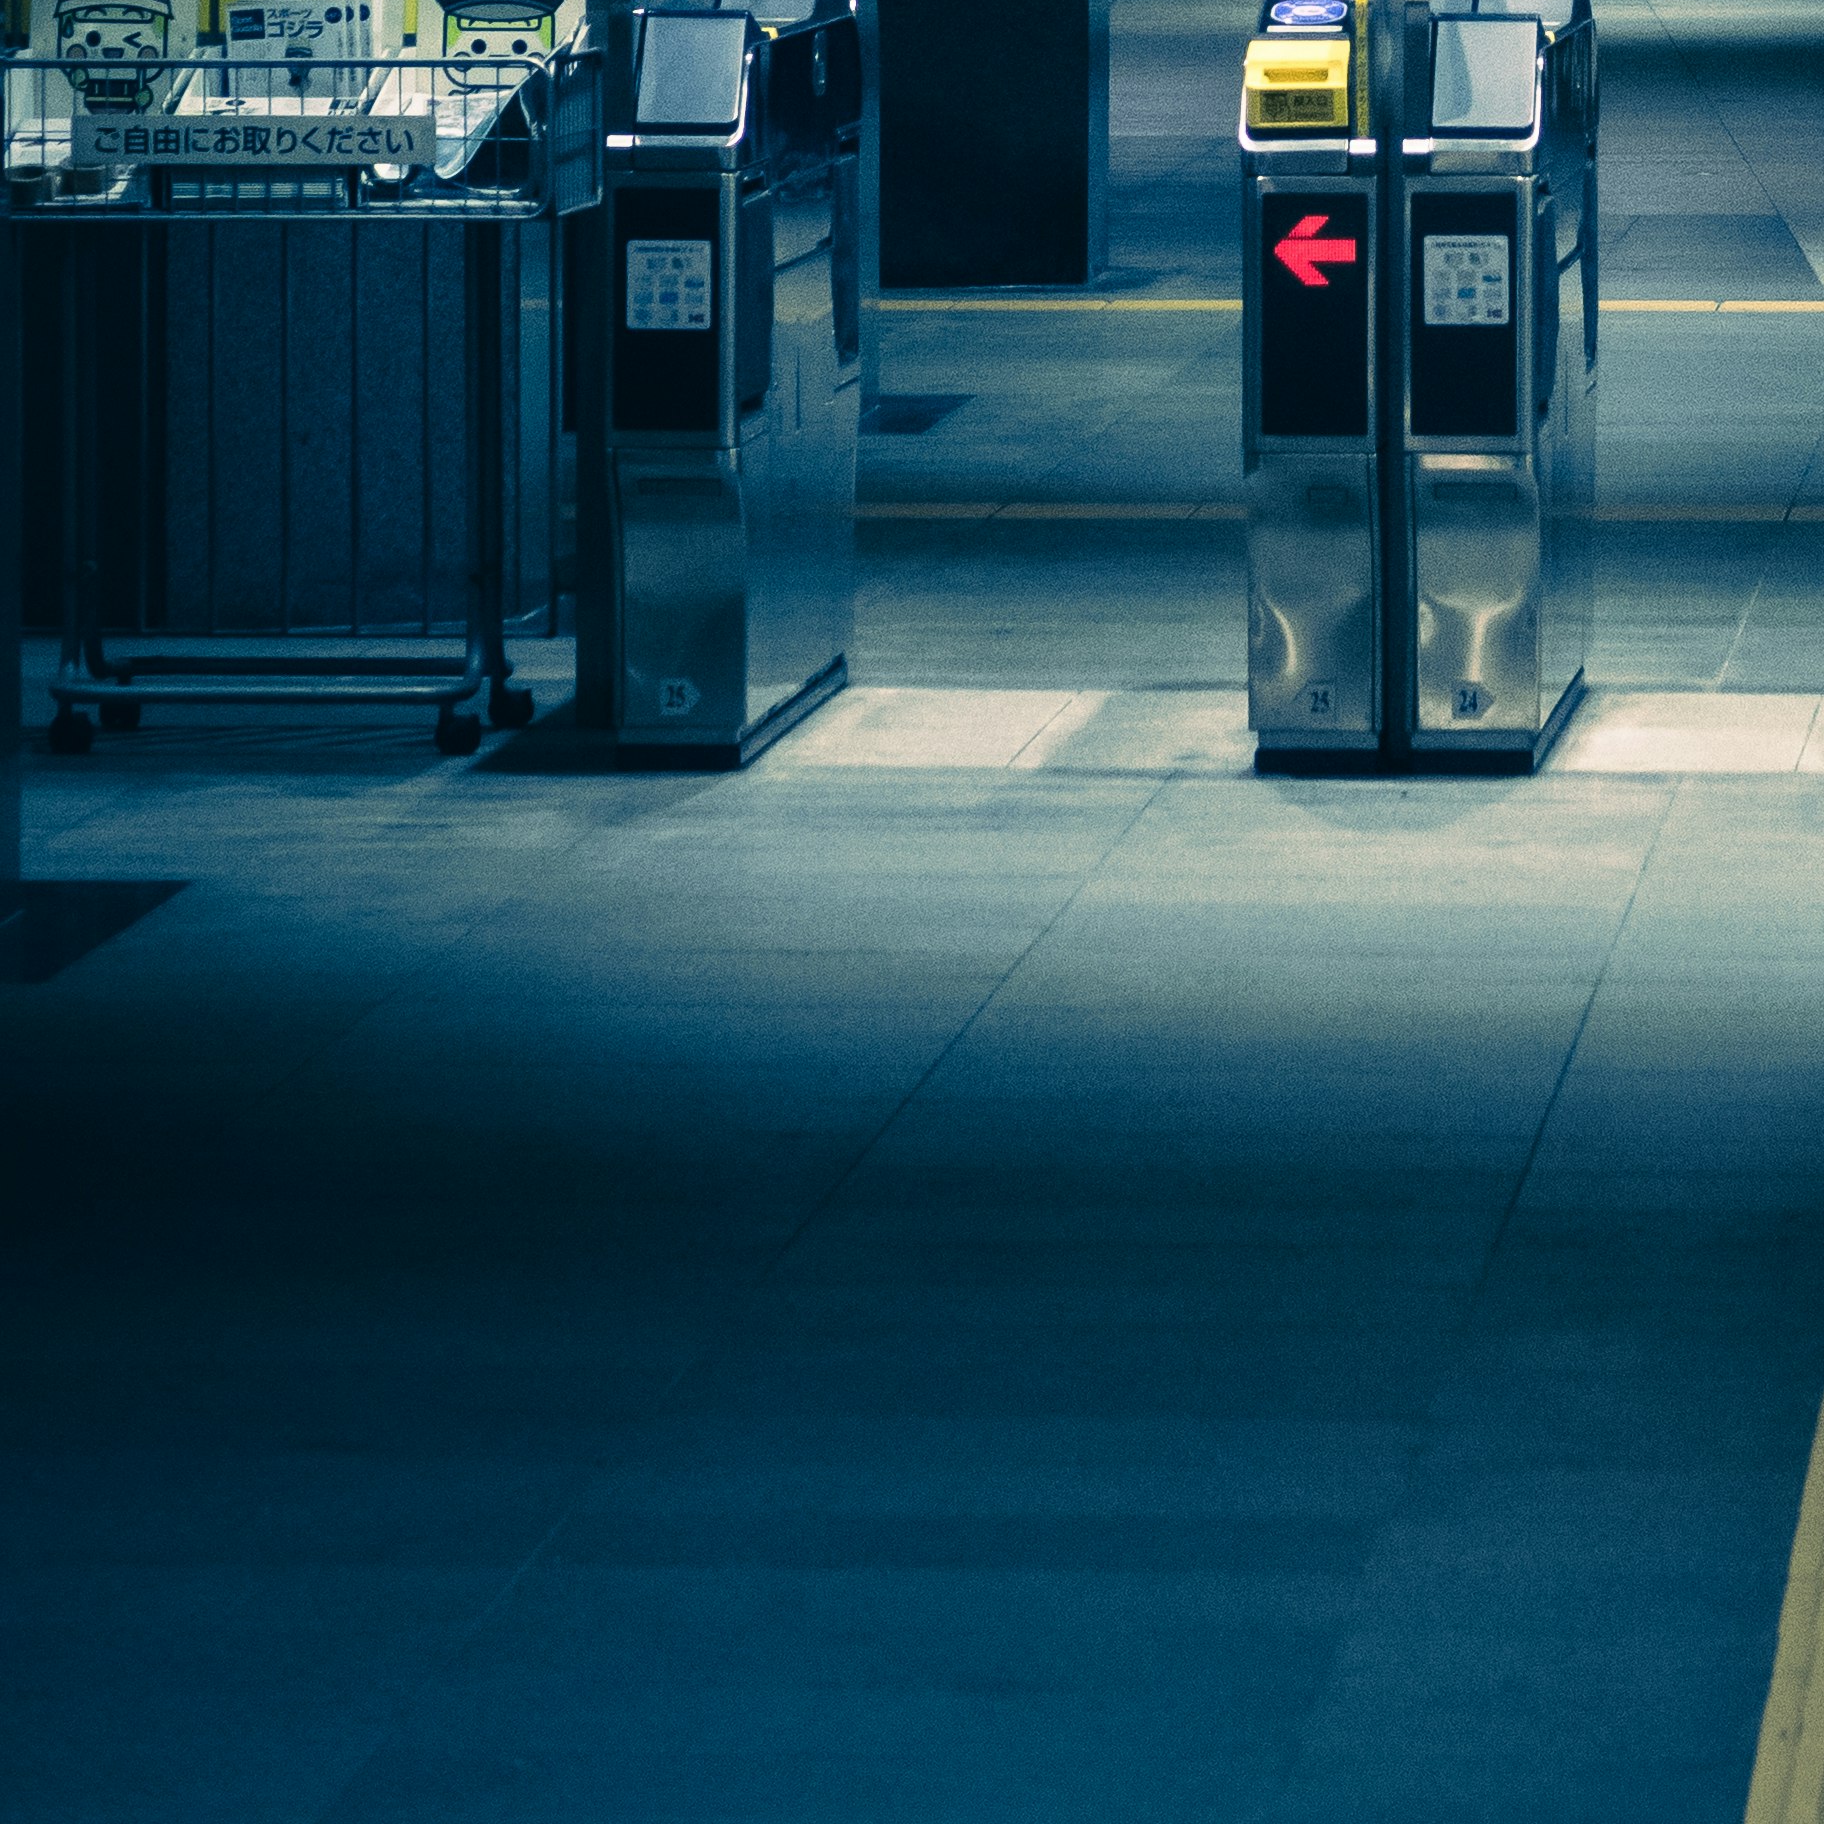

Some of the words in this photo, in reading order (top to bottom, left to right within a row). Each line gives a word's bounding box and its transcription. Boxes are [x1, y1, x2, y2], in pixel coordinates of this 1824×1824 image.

[94, 125, 415, 155] ご自由にお取りください
